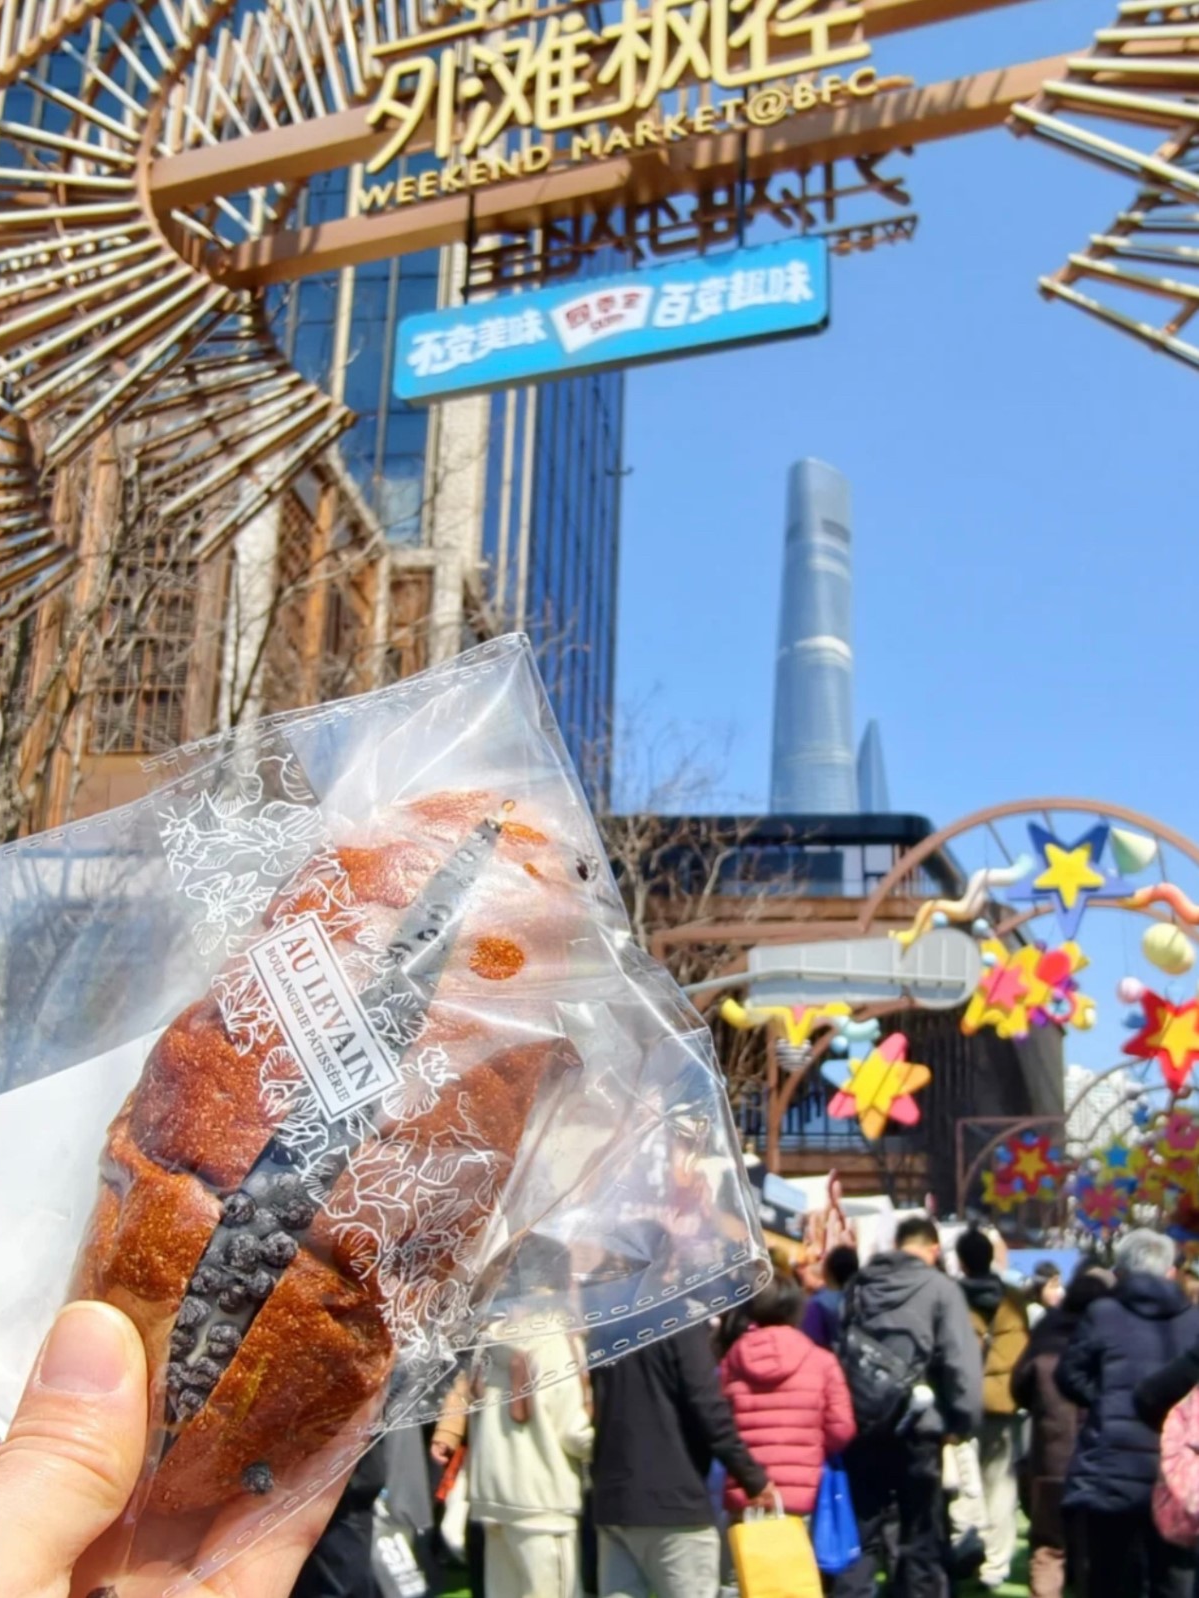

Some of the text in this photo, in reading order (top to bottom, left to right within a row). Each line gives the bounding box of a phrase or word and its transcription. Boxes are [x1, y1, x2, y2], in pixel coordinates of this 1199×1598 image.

[355, 0, 872, 173] 外滩枫径
[358, 66, 877, 210] WEEKEND MARKET@BFC
[265, 945, 313, 1030] BOULANGERIE
[281, 936, 382, 1092] AU LEVAIN
